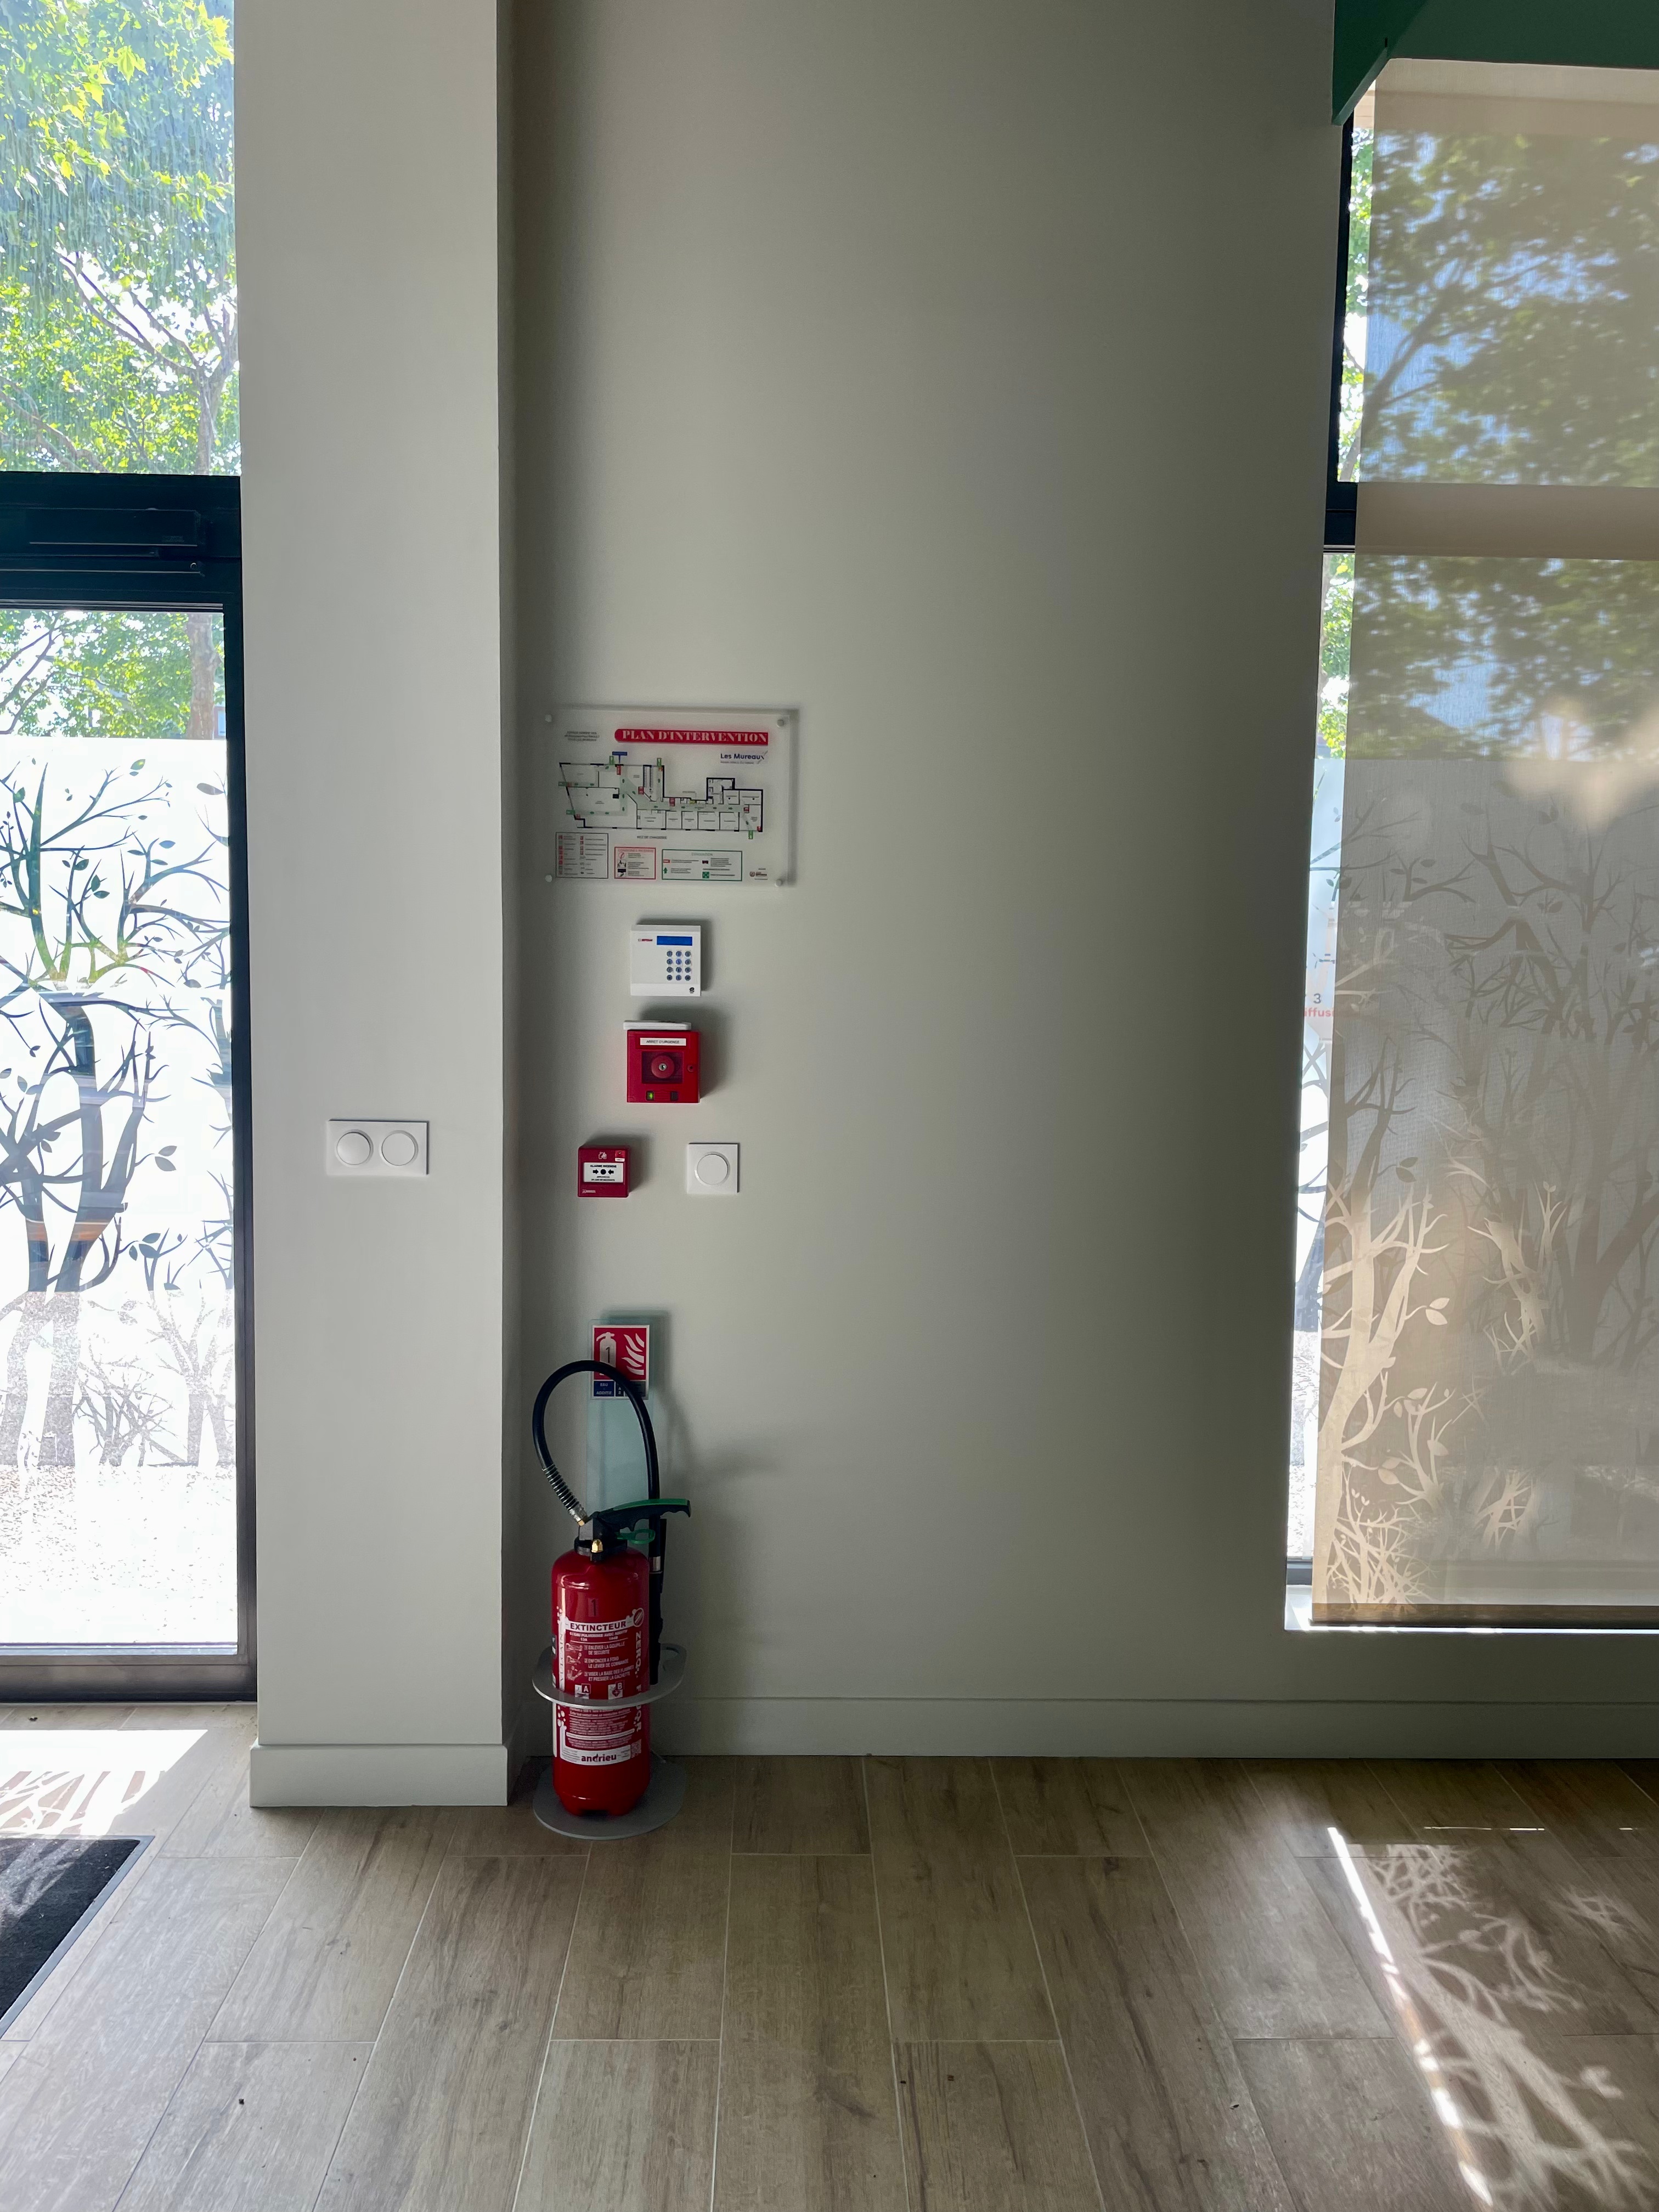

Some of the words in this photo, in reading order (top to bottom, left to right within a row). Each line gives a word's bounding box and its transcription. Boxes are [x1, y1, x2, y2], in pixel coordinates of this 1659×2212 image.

[623, 730, 654, 740] PLAN
[658, 731, 767, 742] D'INTERVENTION
[733, 752, 767, 761] Mureaux
[1313, 994, 1322, 1004] 3
[606, 1347, 610, 1363] 1
[592, 1599, 596, 1616] 1
[570, 1621, 626, 1631] EXTINCTEUR
[581, 1753, 617, 1762] andrieu
